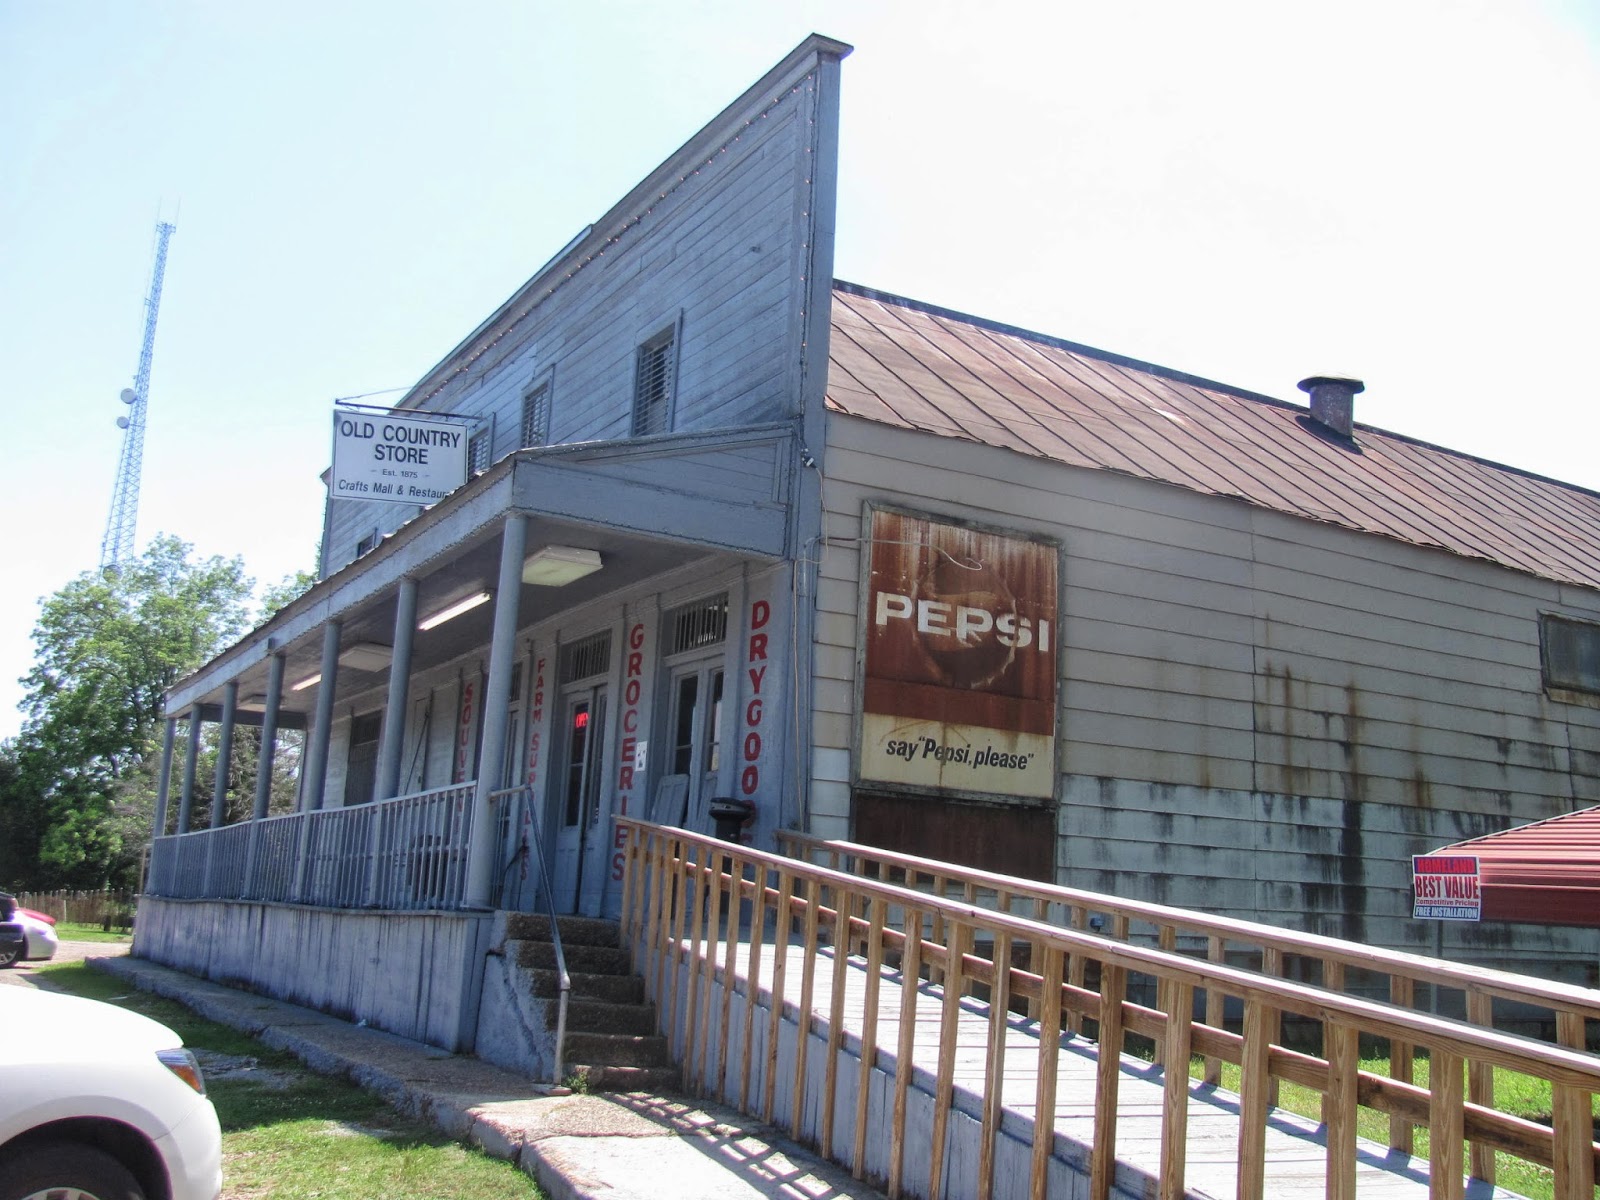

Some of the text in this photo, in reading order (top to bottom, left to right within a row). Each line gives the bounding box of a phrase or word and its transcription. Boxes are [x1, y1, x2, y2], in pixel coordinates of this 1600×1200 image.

[341, 420, 461, 448] OLD COUNTRY
[374, 444, 429, 465] STORE
[382, 468, 418, 479] Est. 1875
[338, 479, 448, 499] Crafts Mall & Restaur
[875, 591, 1050, 652] PEPSI
[532, 658, 546, 722] FARM
[612, 623, 645, 881] GROCERIES
[886, 737, 918, 762] say
[1417, 858, 1476, 873] HOMELAND
[1415, 875, 1480, 899] BEST VALUE
[1416, 906, 1478, 918] FREE INSTALLATION
